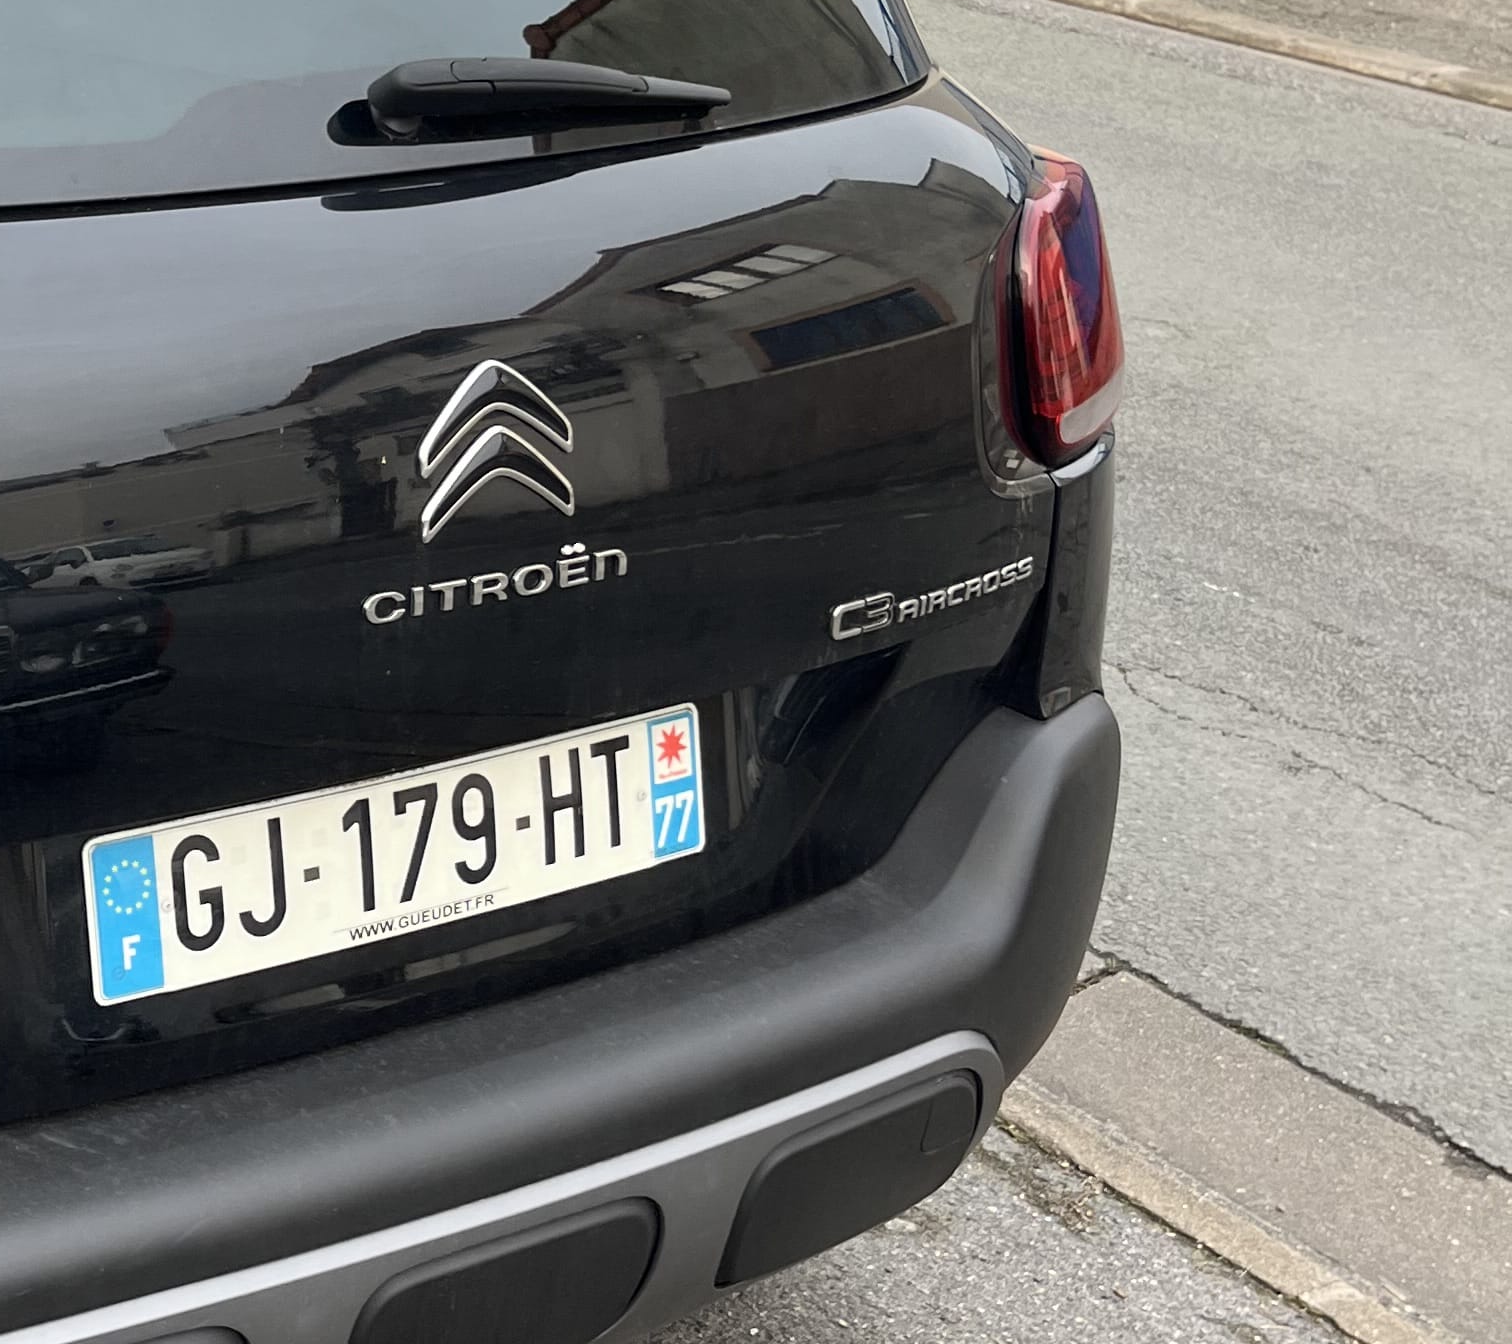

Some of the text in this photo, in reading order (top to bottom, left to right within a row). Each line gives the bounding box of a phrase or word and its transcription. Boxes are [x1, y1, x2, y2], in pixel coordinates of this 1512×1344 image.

[831, 556, 1034, 640] C3 AIRCROSS
[171, 734, 630, 952] GJ-179-HT
[655, 790, 694, 849] 77
[349, 894, 495, 941] WWW.GUEUDET.FR
[122, 934, 141, 971] F
